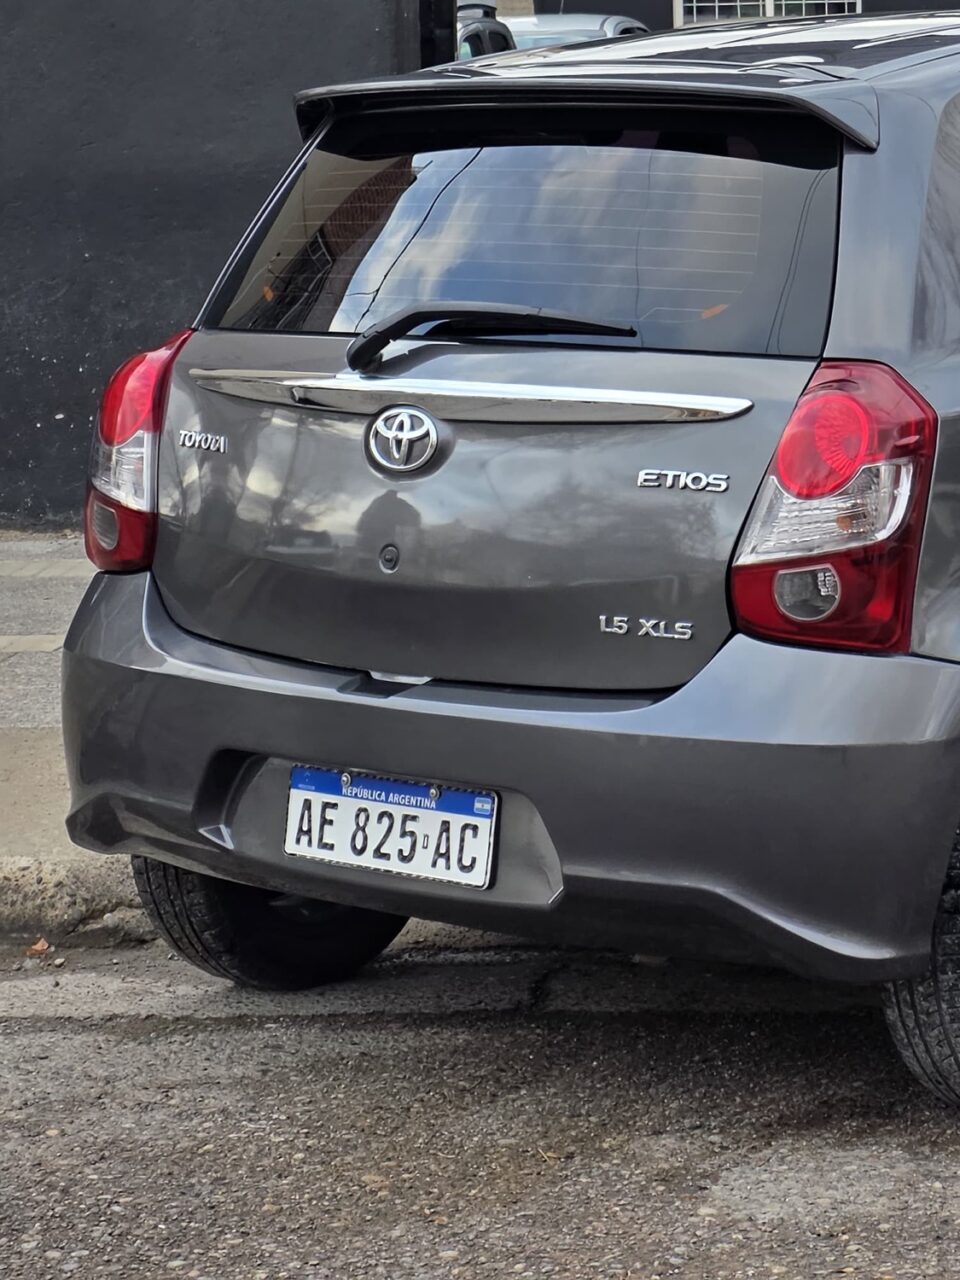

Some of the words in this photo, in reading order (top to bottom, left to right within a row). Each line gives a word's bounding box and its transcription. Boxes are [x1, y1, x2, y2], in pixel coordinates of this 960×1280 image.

[179, 429, 228, 454] TOYOTA
[637, 469, 729, 492] ETIOS
[637, 619, 694, 640] XLS
[342, 786, 386, 802] REPÚBLICA
[388, 792, 436, 809] ARGENTINA
[295, 798, 339, 851] AE
[350, 806, 419, 864] 825
[431, 820, 479, 874] AC
